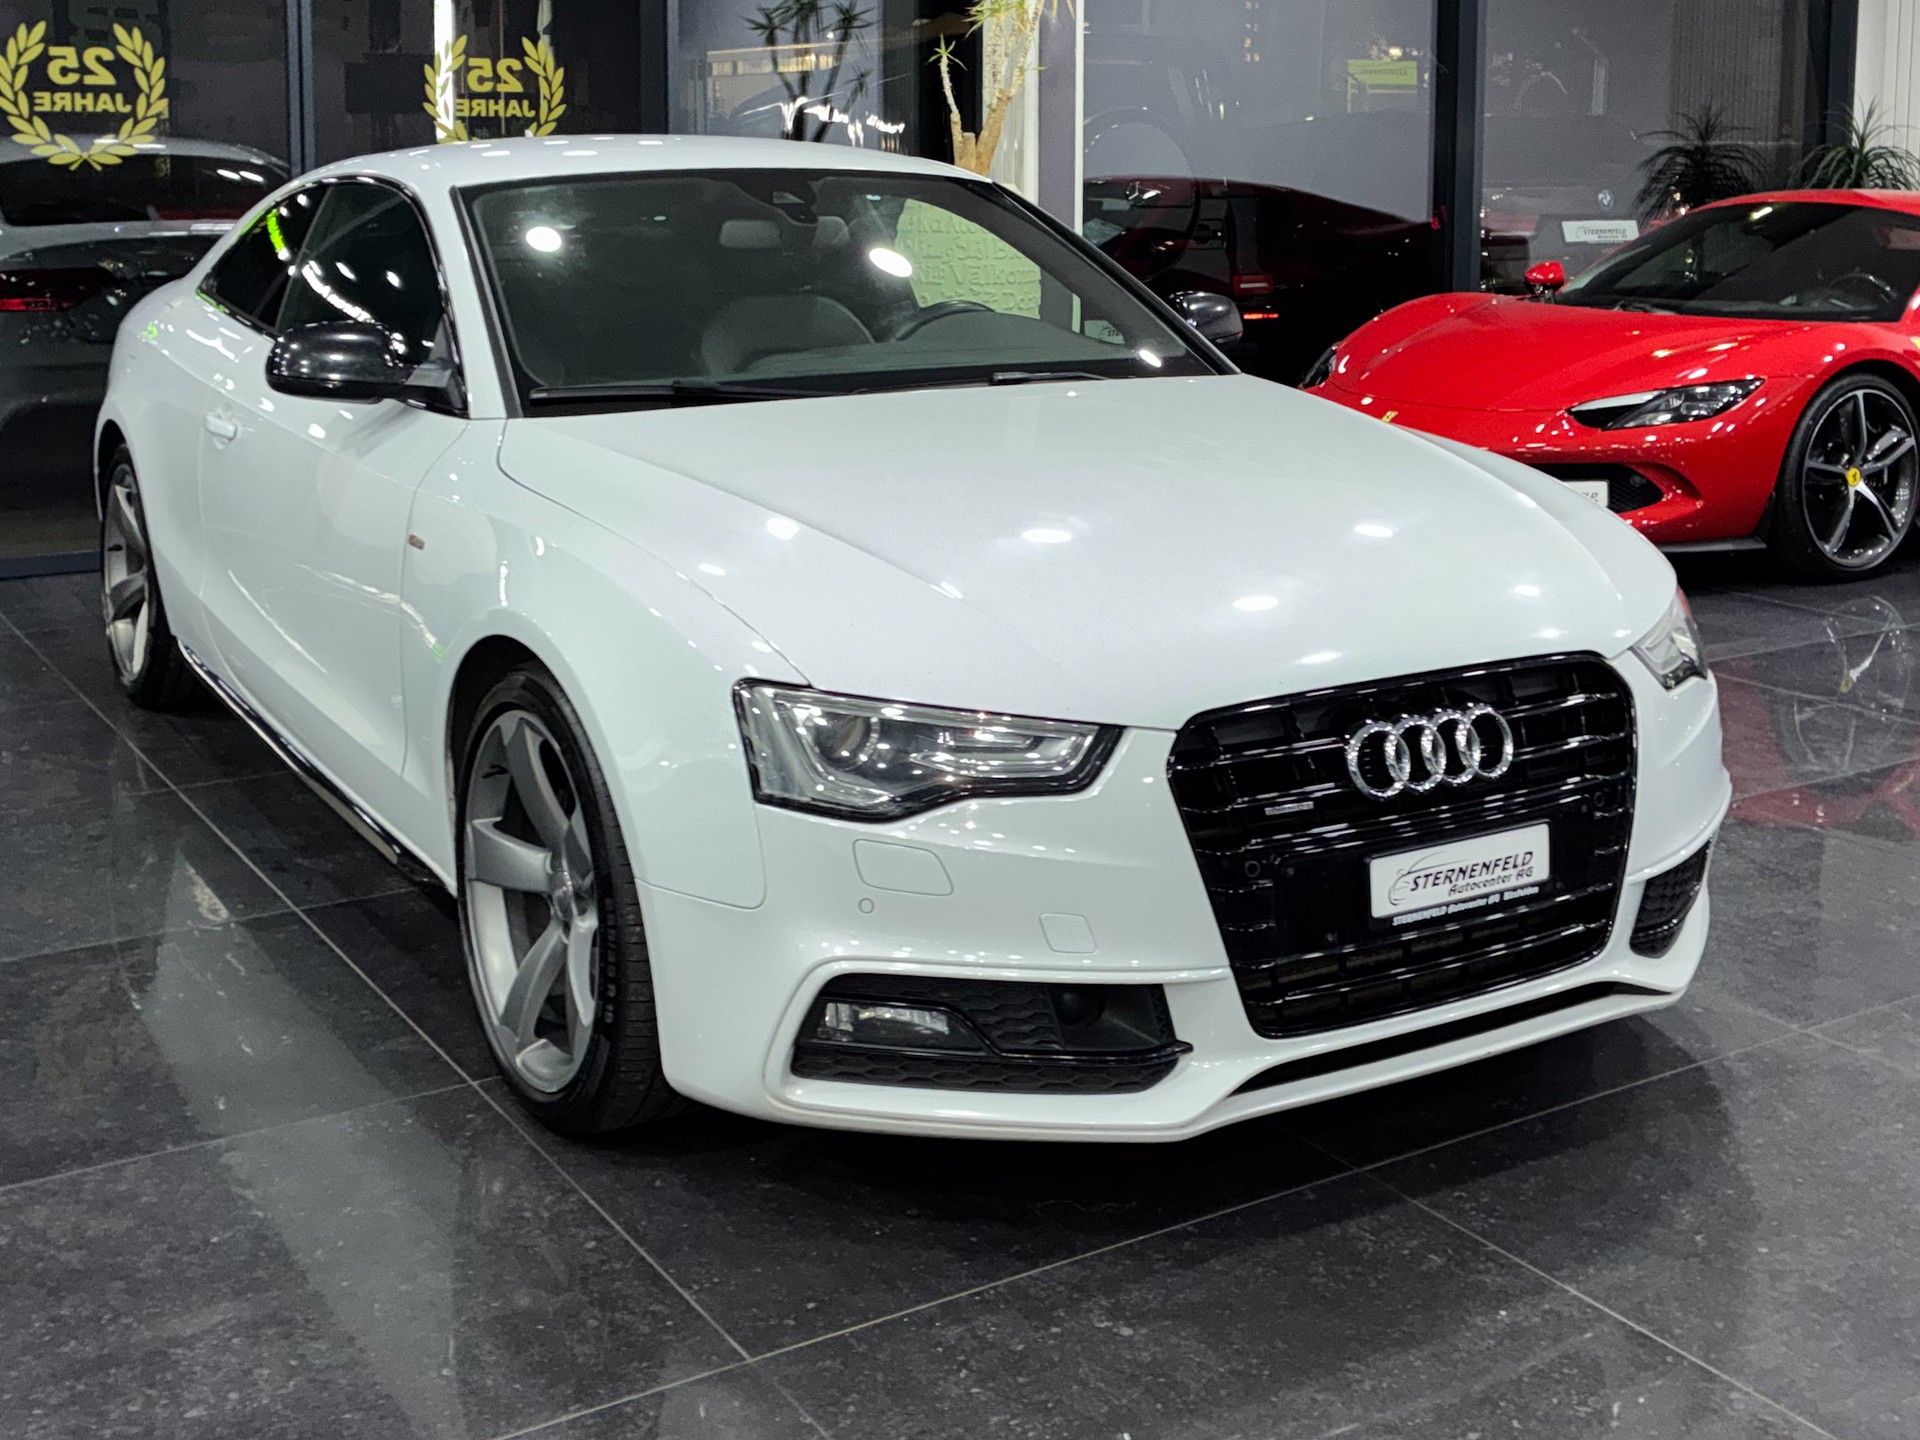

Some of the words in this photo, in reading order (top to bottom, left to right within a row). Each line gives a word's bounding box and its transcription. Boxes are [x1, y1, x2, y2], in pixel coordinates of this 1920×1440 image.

[1410, 851, 1534, 892] STERNENFELD
[1448, 873, 1513, 897] Autocenter
[1515, 866, 1534, 881] AG
